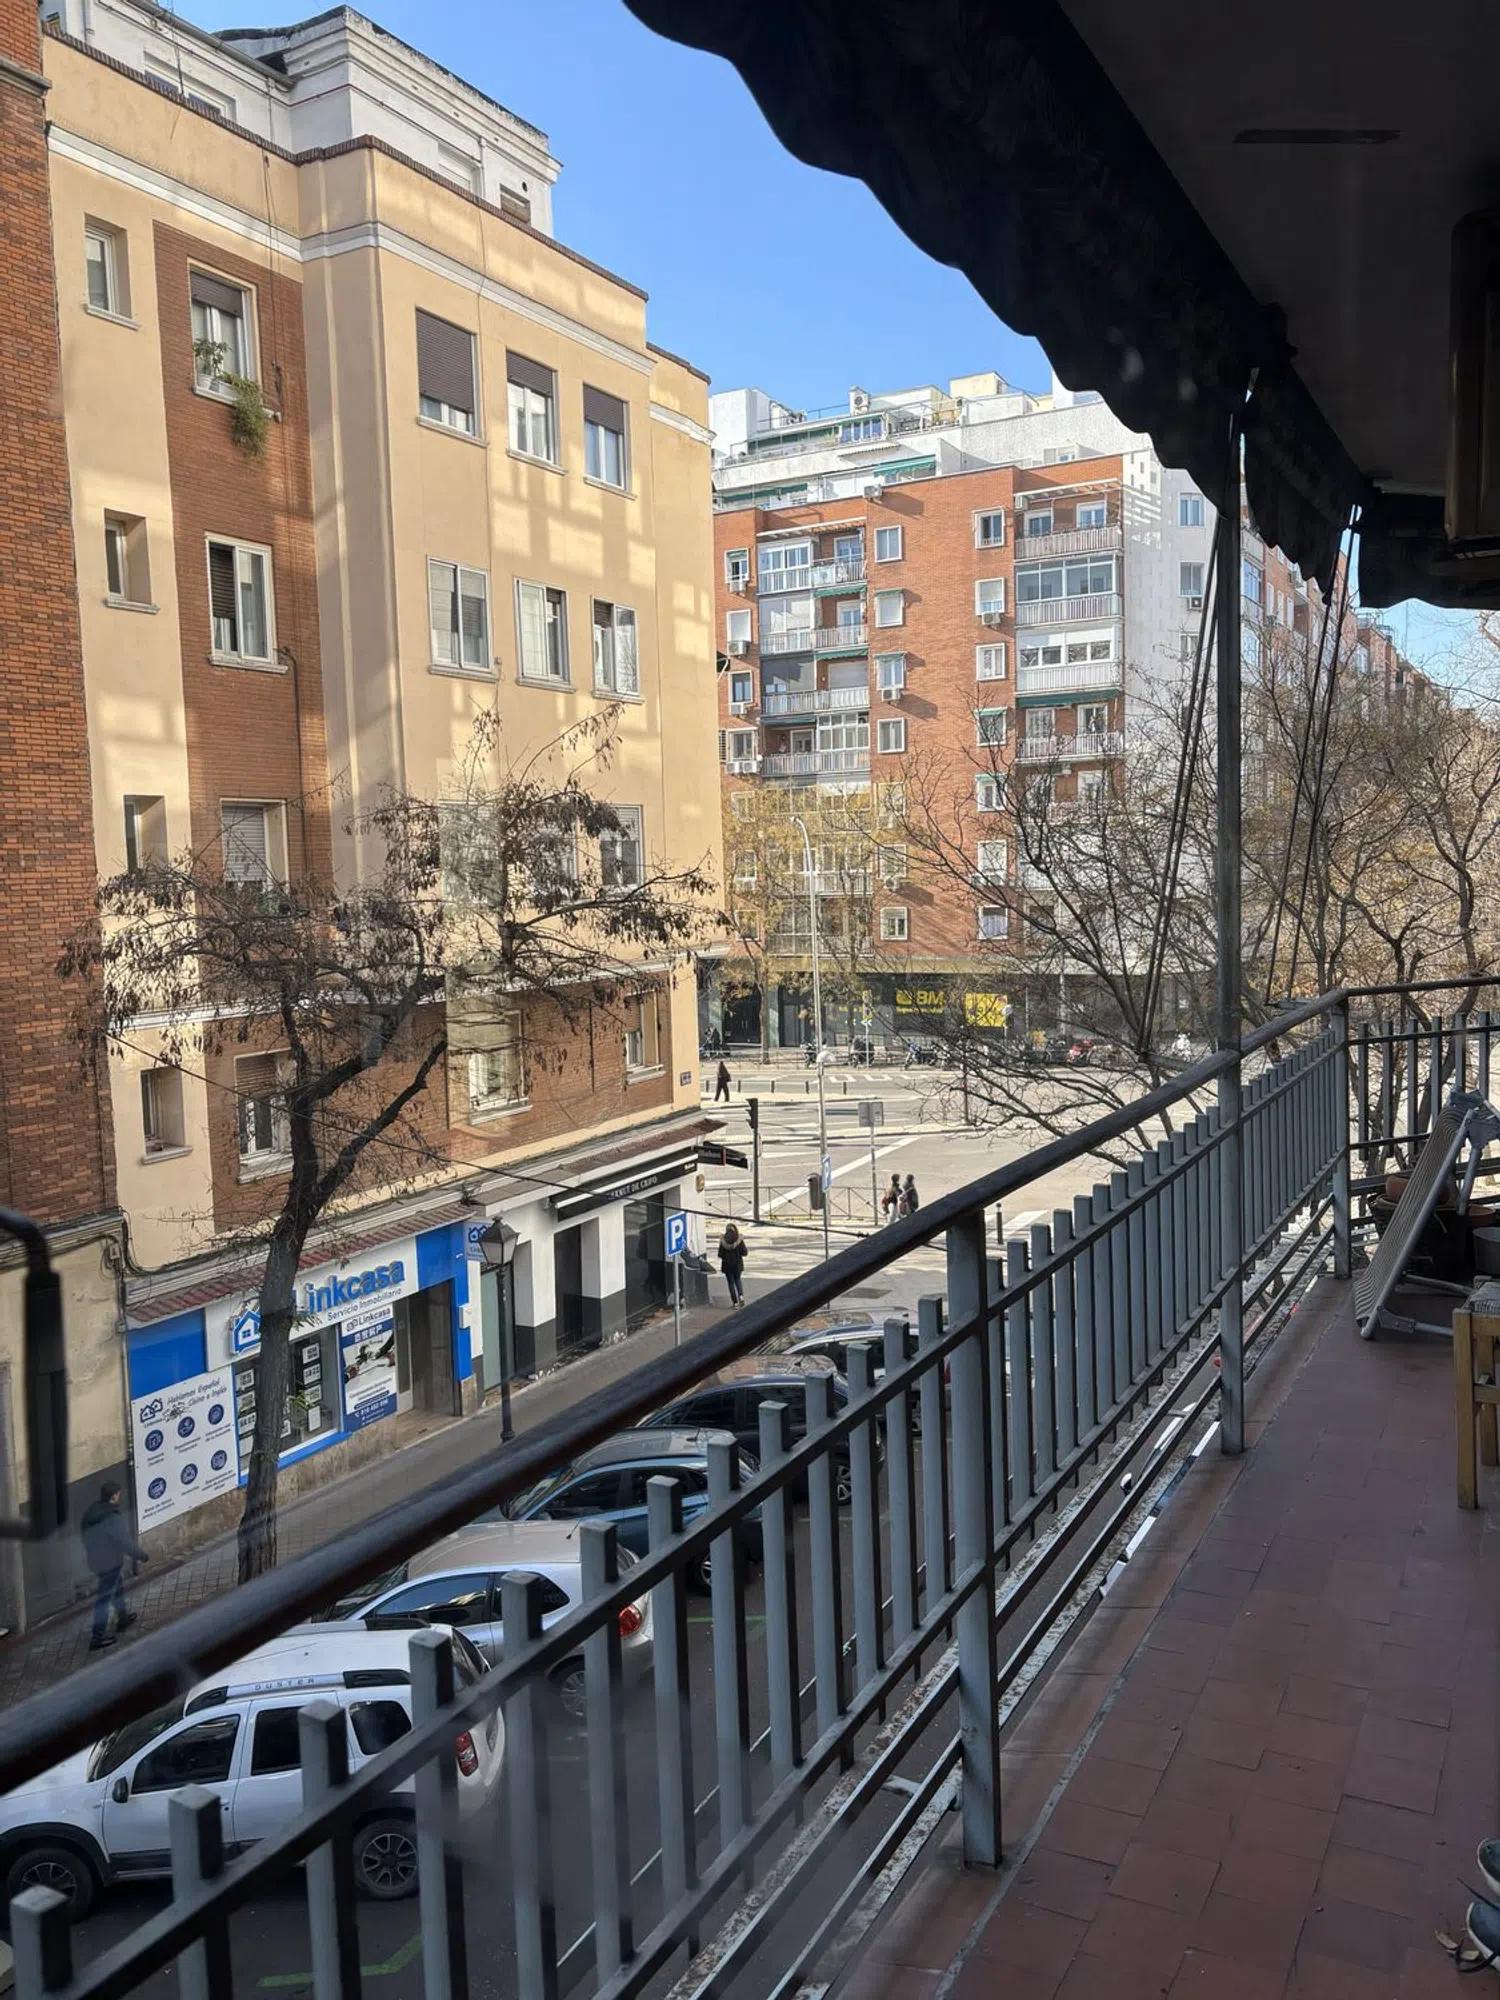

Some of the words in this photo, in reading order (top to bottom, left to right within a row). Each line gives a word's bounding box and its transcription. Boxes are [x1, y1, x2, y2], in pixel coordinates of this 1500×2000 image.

[917, 989, 944, 1006] BM
[671, 1219, 683, 1250] P
[327, 1304, 359, 1321] Servicio
[360, 1288, 402, 1308] Inmobiliario
[359, 1308, 391, 1324] Linkcasa
[254, 1678, 314, 1690] DUSTER
